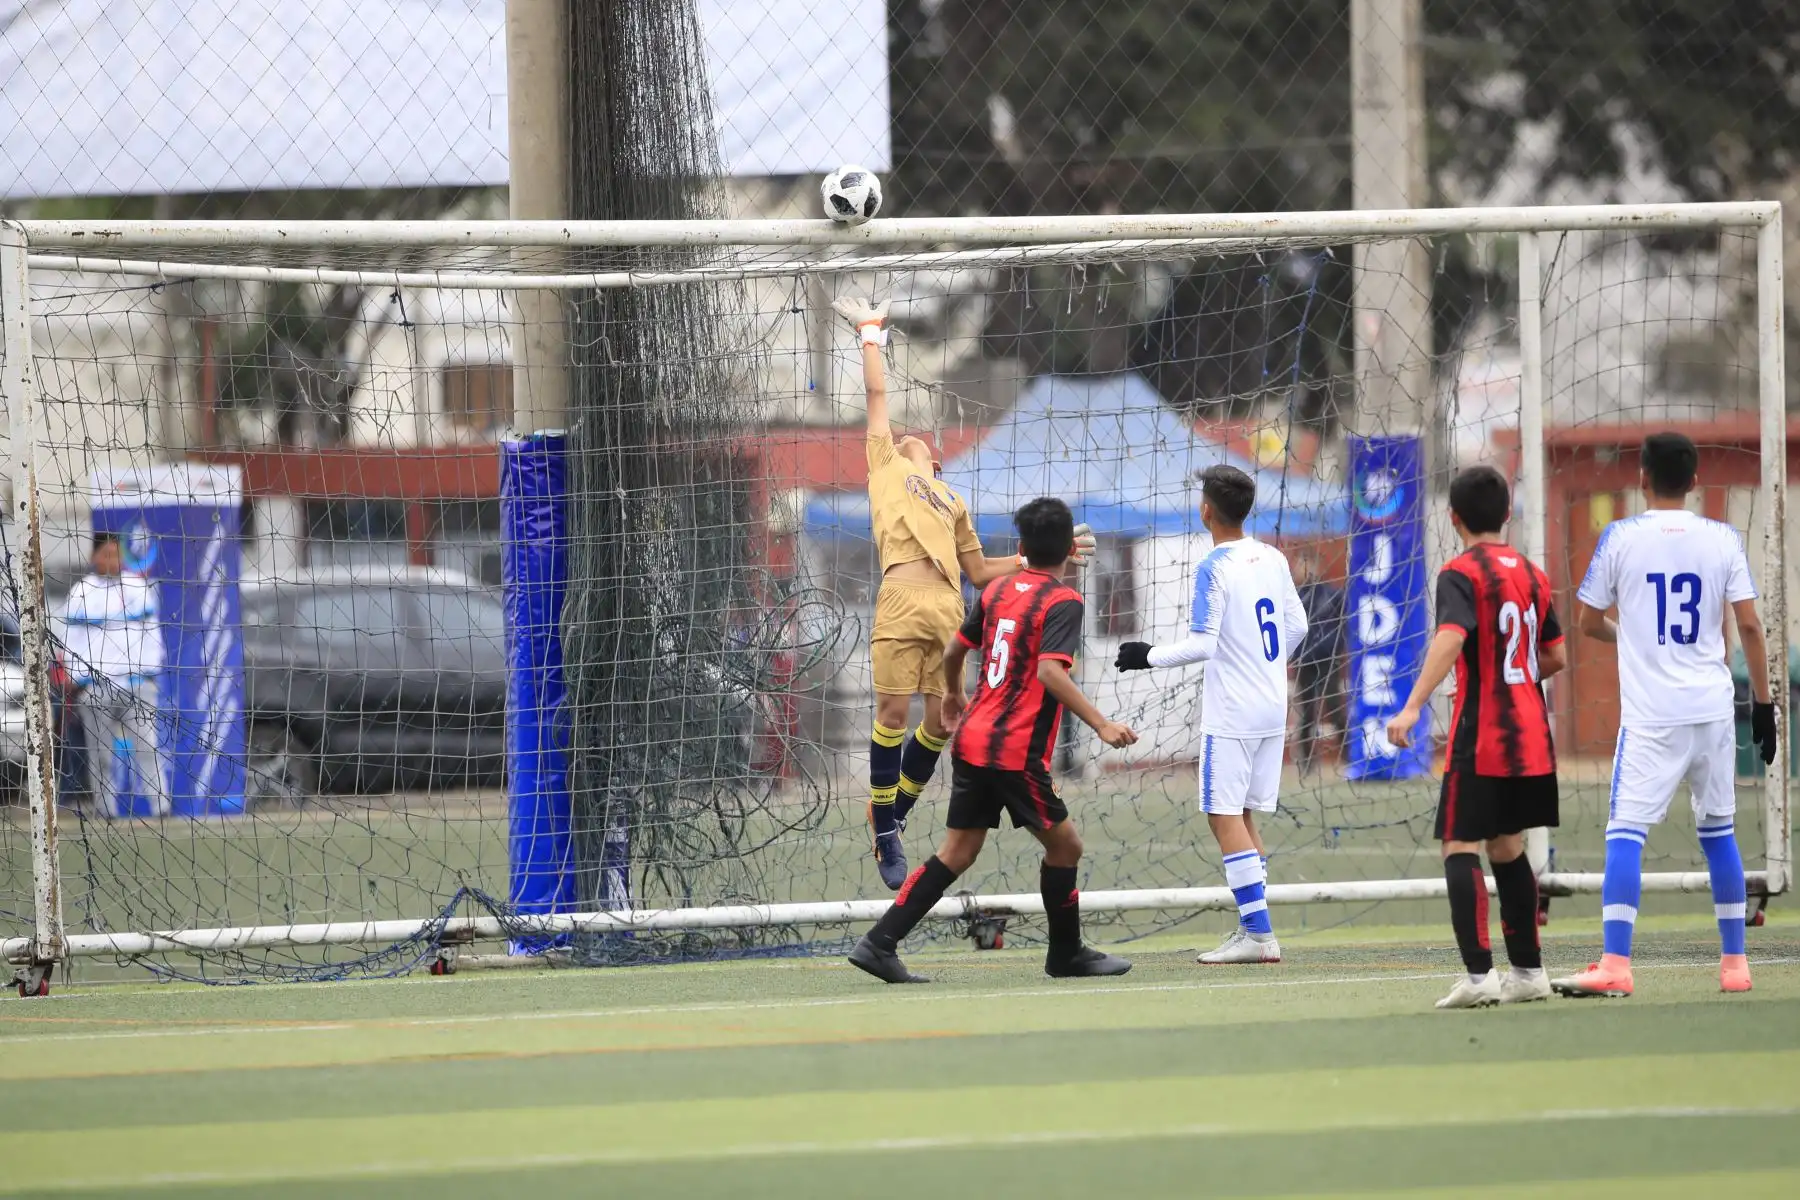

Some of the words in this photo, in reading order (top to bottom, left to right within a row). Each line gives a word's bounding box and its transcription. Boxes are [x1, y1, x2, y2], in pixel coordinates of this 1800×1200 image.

[1255, 597, 1280, 662] 6
[1498, 601, 1539, 684] 21
[1646, 571, 1702, 645] 13
[987, 618, 1016, 689] 5
